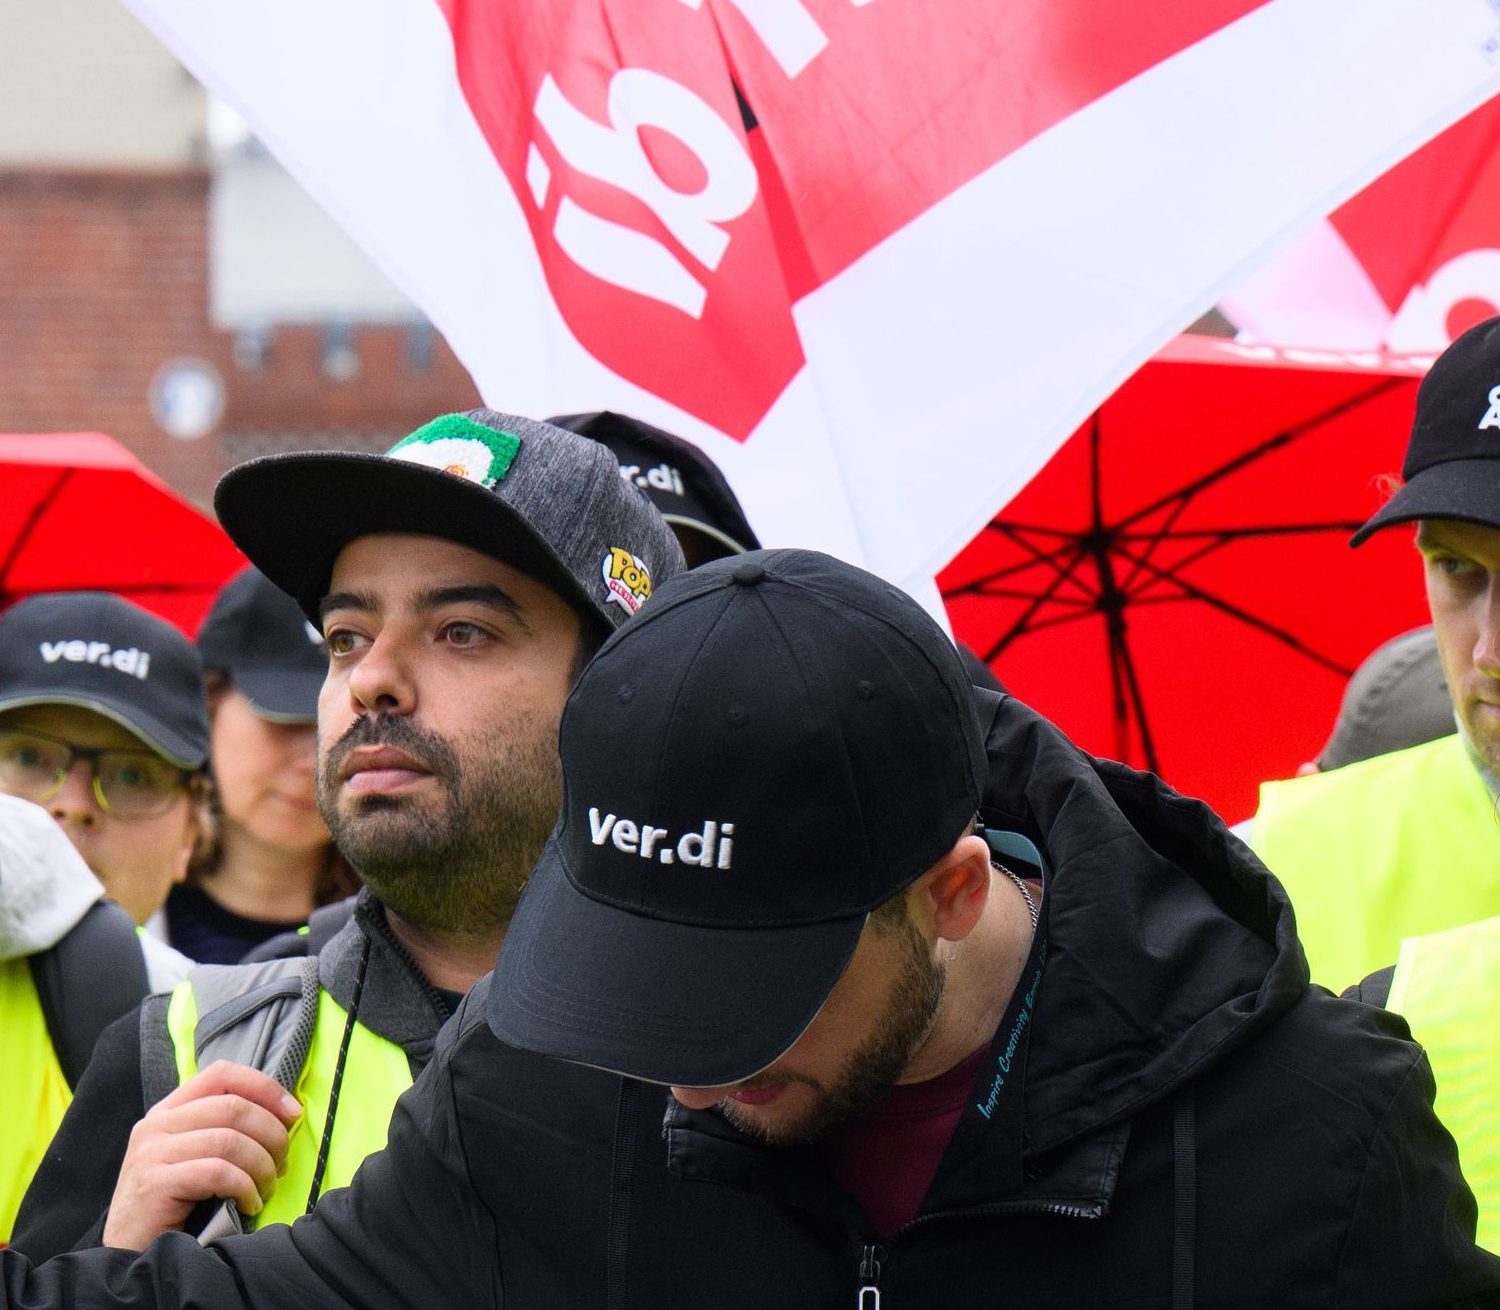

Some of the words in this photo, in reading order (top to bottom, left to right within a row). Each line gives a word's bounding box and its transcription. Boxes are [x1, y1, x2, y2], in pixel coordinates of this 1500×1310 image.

[619, 464, 685, 497] r.di
[39, 638, 151, 680] ver.di
[588, 807, 735, 870] ver.di
[976, 1073, 1004, 1120] Inspire
[998, 1008, 1029, 1074] Creativity
